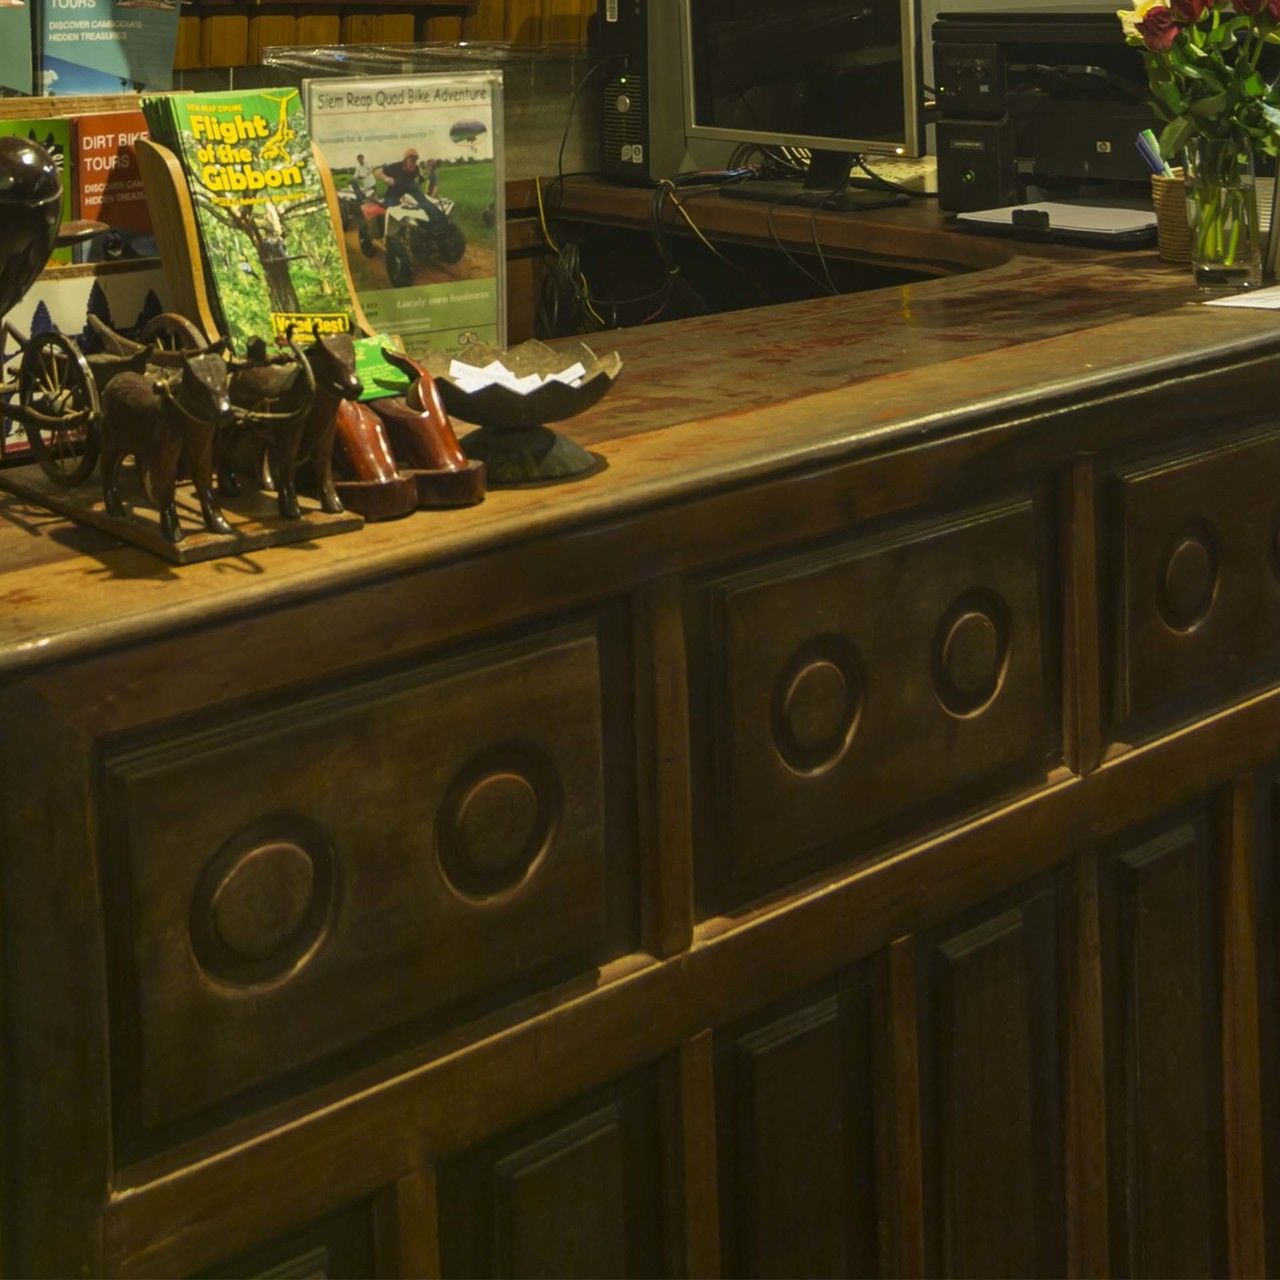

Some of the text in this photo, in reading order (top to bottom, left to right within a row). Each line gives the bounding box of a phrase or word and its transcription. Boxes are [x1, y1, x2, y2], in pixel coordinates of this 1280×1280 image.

[49, 20, 90, 30] DISCOVER
[49, 32, 127, 42] HIDDEN TREASURES
[317, 87, 488, 110] Siem Reap Quad Bike Adventure
[190, 114, 270, 144] Flight
[83, 134, 115, 150] DIRT
[197, 143, 253, 163] of the
[83, 155, 129, 171] TOURS
[201, 164, 303, 191] Gibbon
